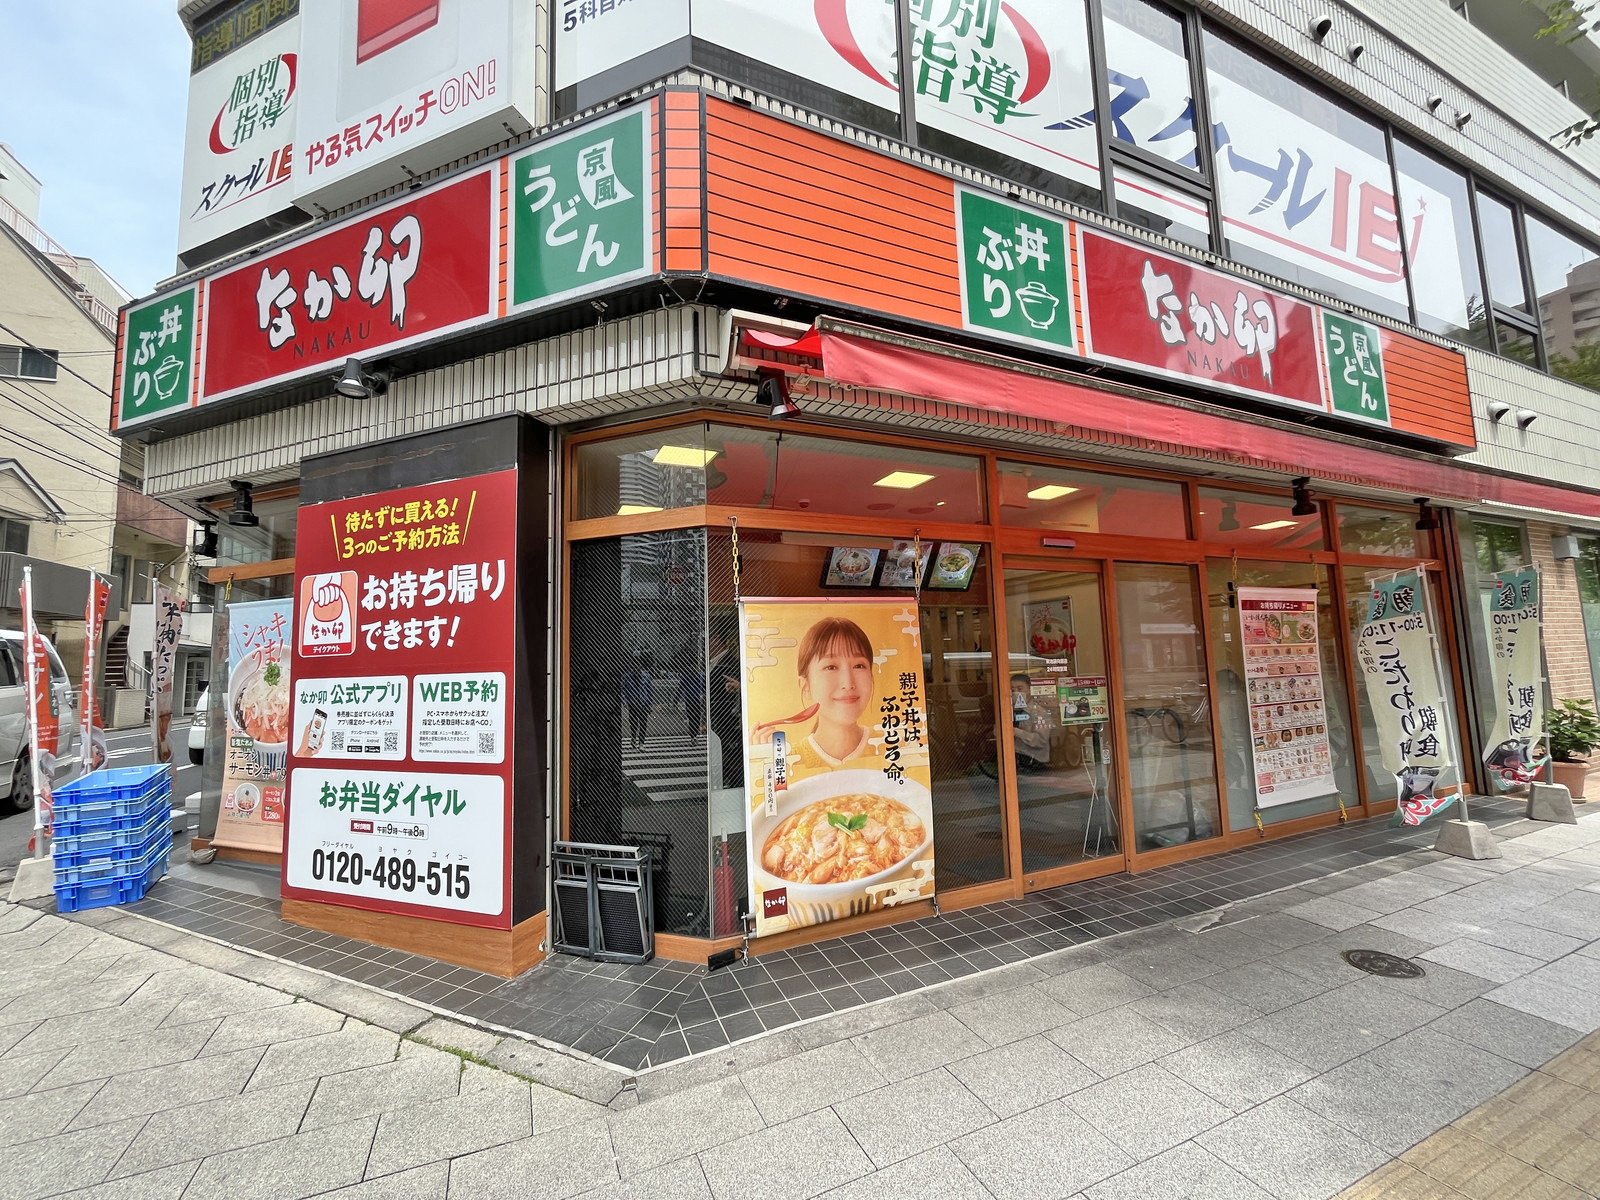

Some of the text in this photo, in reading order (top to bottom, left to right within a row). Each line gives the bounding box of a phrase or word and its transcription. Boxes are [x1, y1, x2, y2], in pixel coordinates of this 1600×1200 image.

[228, 54, 282, 114] 個別
[231, 89, 293, 146] 指導
[306, 58, 496, 175] やる気スイッチON!
[582, 147, 620, 208] 京風
[524, 164, 620, 274] うどん
[256, 214, 422, 351] なか卵
[293, 320, 371, 360] NAKAU
[1140, 259, 1277, 387] なか卵
[1187, 350, 1250, 381] NAKAU
[1329, 324, 1378, 411] うどん
[345, 497, 460, 533] 待たずに買える!
[342, 522, 461, 559] 3つのご予約方法
[361, 559, 506, 611] お持ち帰り
[242, 612, 287, 648] シャキ
[311, 622, 344, 640] なか卵
[361, 615, 461, 651] できます!
[312, 646, 341, 654] テイクアウト
[300, 690, 328, 705] なか卵
[330, 681, 402, 705] 公式アプリ
[419, 680, 499, 703] WEB予約
[229, 749, 258, 761] オニオン
[319, 780, 467, 818] お弁当ダイヤル
[312, 849, 470, 899] 0120-489-515
